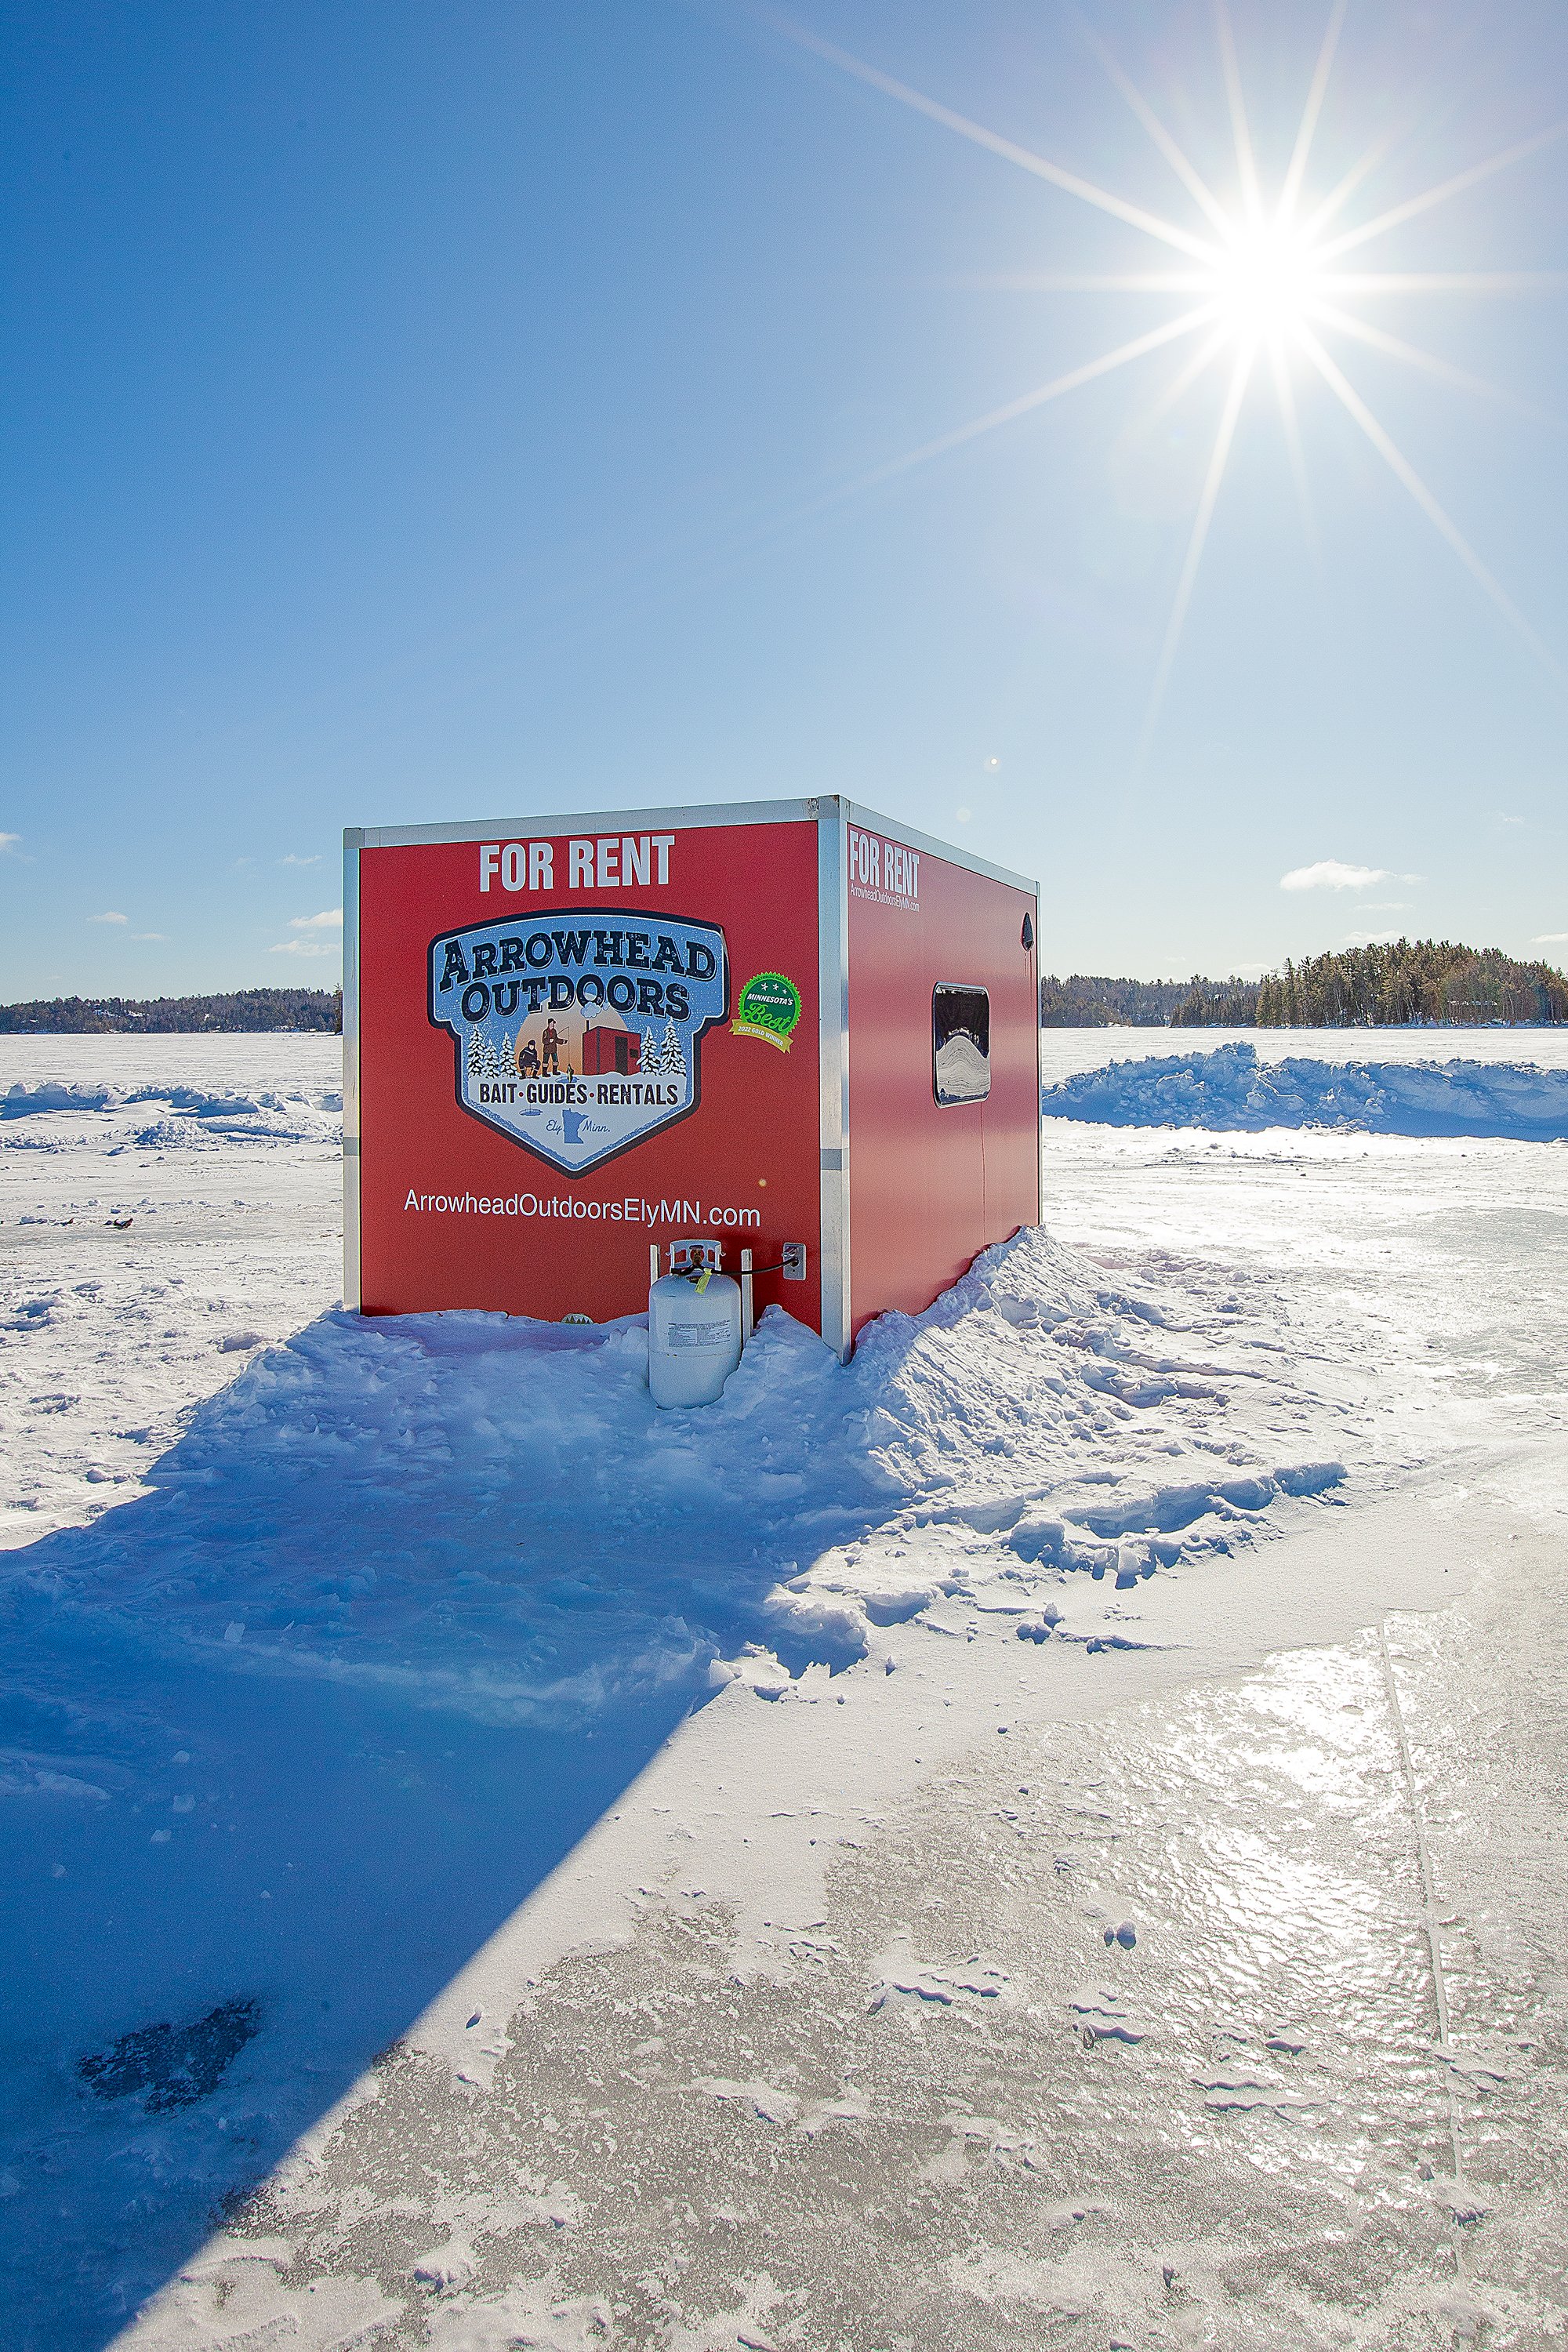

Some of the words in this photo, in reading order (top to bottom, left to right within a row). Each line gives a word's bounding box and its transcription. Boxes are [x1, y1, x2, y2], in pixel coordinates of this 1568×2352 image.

[479, 842, 554, 892] FOR
[568, 835, 675, 889] RENT
[850, 830, 880, 887] FOR
[884, 844, 919, 898] RENT
[440, 930, 717, 992] ARROWHEAD
[461, 974, 691, 1023] OUTDOORS
[747, 993, 793, 1006] MINNESOTA'S
[743, 1003, 791, 1031] Best
[751, 1027, 764, 1036] GOLD
[765, 1032, 783, 1047] WINNER
[480, 1083, 517, 1104] BAIT
[526, 1083, 588, 1105] GUIDES
[597, 1083, 679, 1105] RENTALS
[546, 1119, 562, 1136] Ely
[582, 1120, 611, 1133] Minn.
[404, 1189, 760, 1228] ArrowheadOutdoorsElyMN.com
